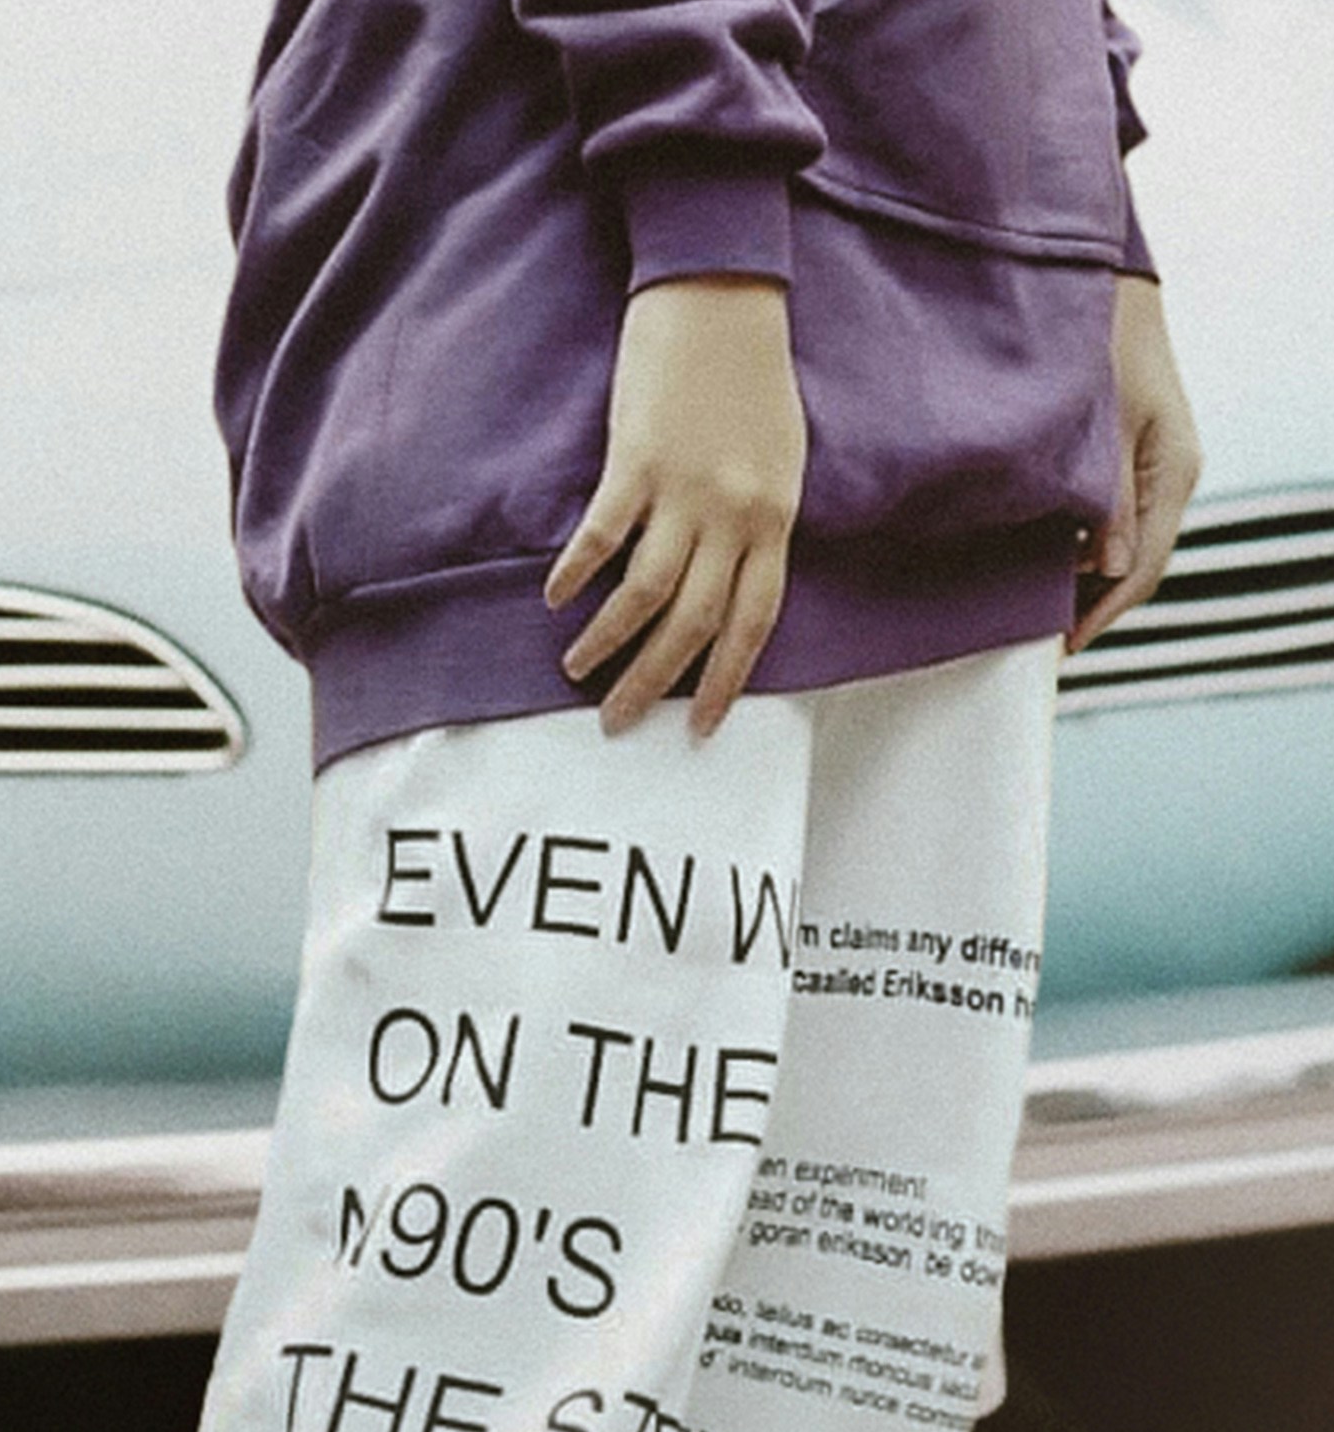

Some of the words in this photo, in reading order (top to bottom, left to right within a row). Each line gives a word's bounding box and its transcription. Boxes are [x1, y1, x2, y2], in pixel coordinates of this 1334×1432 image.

[376, 830, 694, 954] EVEN
[883, 969, 1005, 1014] Eriksson
[369, 1007, 519, 1110] ON
[568, 1022, 779, 1146] THE
